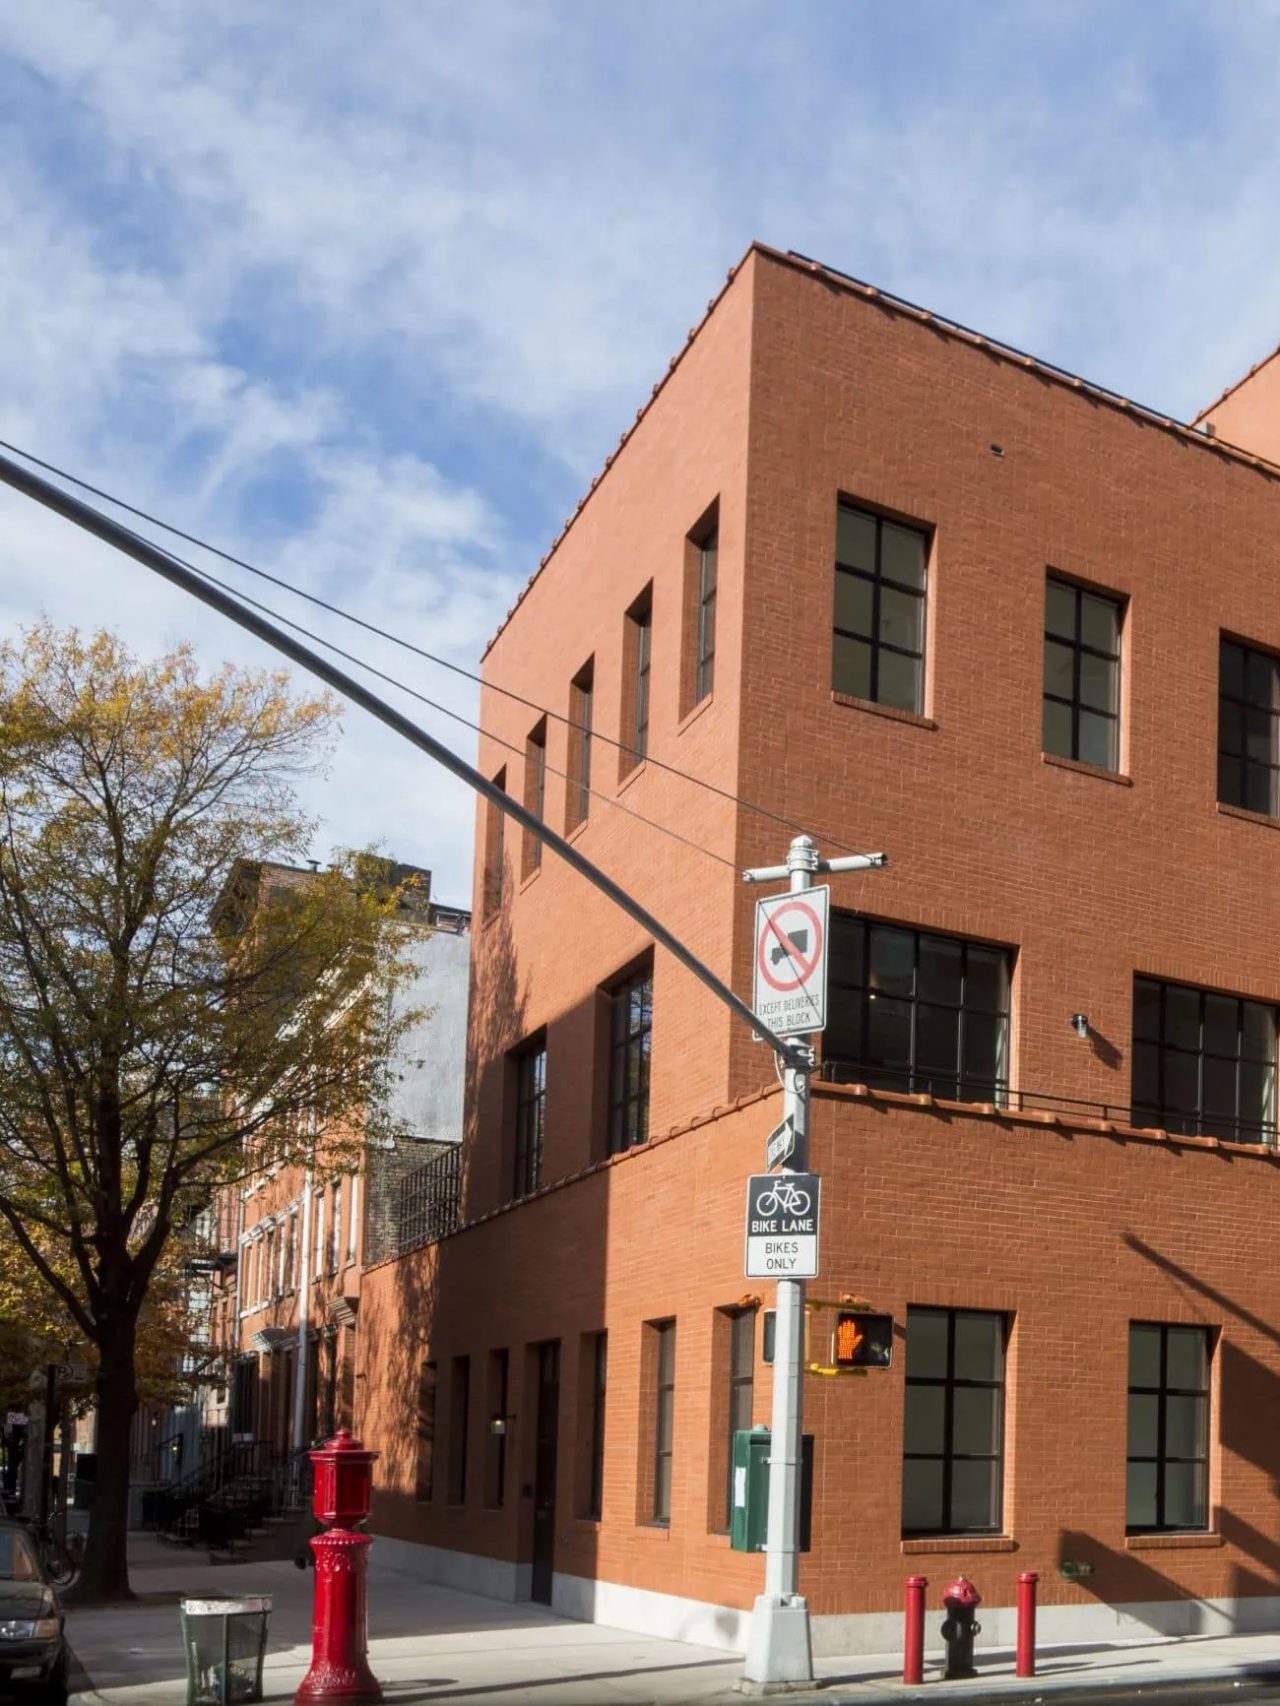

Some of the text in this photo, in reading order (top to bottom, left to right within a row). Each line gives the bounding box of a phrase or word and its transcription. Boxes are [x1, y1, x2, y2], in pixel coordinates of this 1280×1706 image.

[760, 994, 819, 1015] EXCEPT DELIVERIES
[768, 1012, 810, 1028] THIS BLOCK
[751, 1219, 813, 1233] BIKE LANE
[765, 1242, 799, 1254] BIKES
[766, 1258, 796, 1270] ONLY
